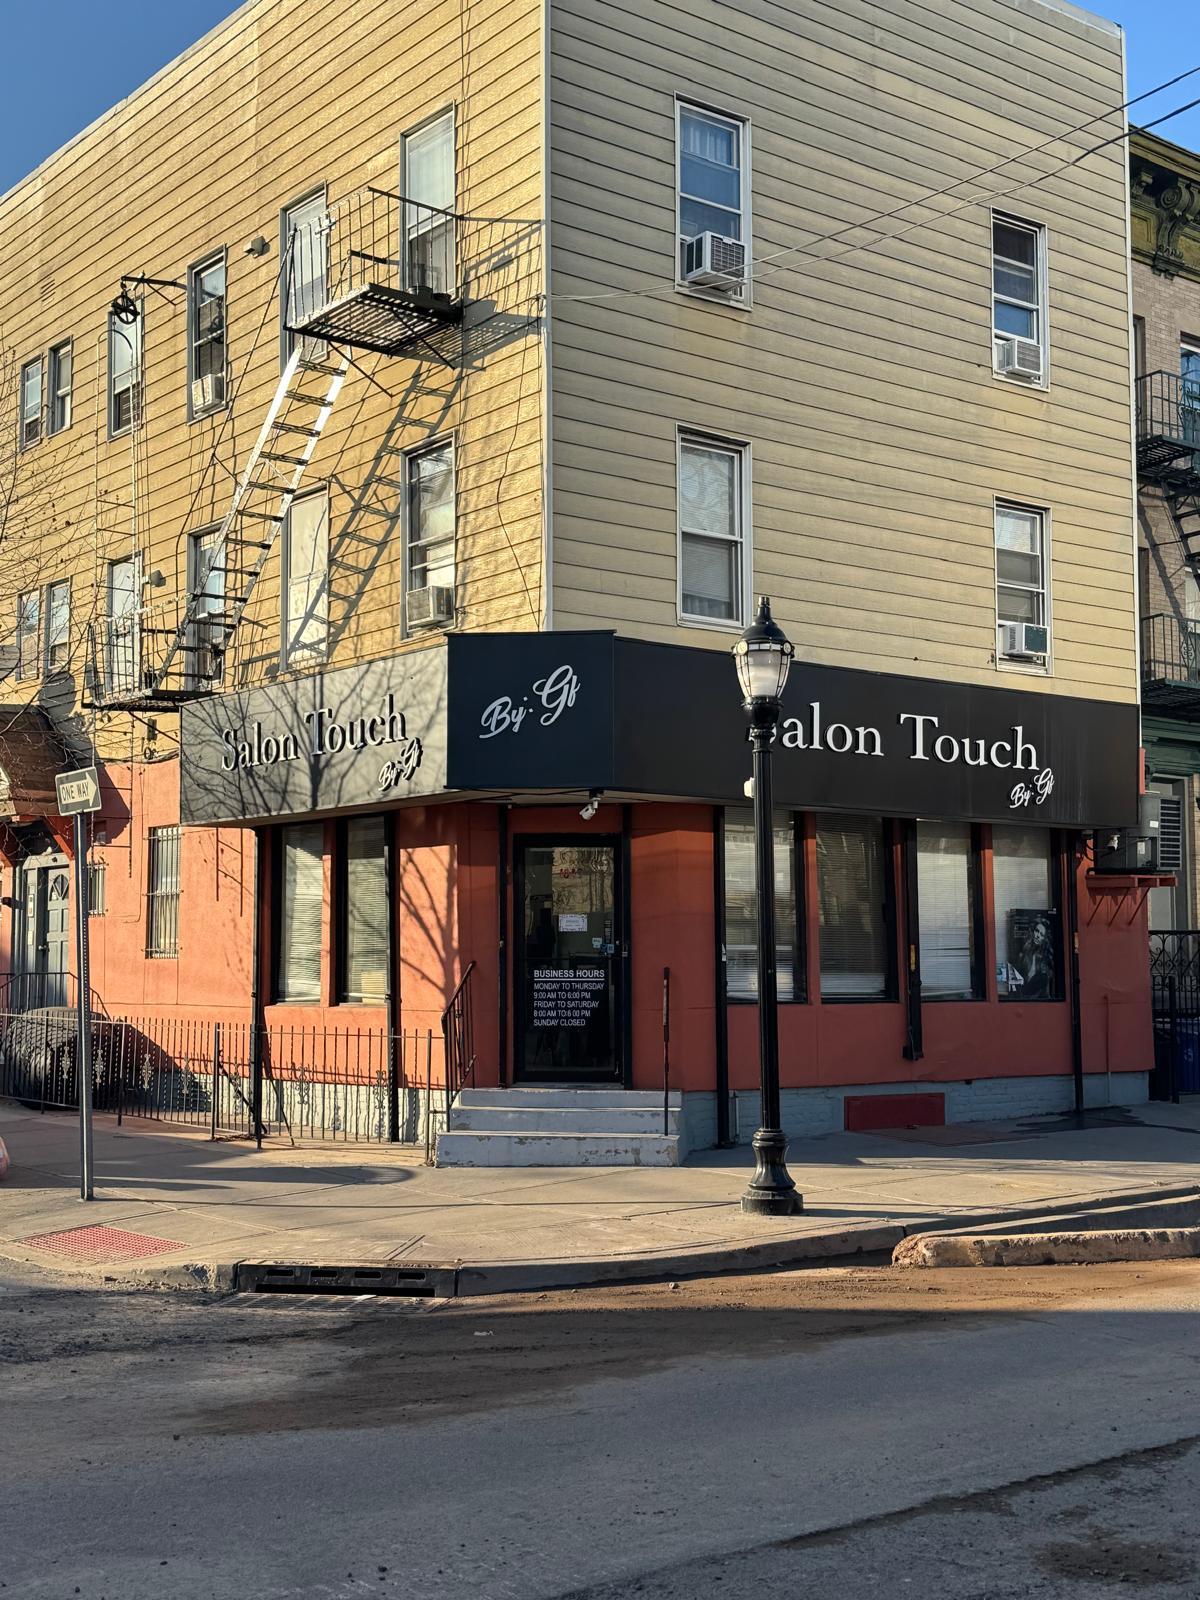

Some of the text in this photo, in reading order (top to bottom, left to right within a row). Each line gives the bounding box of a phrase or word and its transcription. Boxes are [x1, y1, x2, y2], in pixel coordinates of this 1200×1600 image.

[220, 692, 408, 772] Salon Touch
[899, 713, 1040, 772] Touch
[61, 782, 90, 801] ONE WAY
[533, 969, 605, 978] BUSINESS HOURS
[533, 982, 605, 990] MONDAY TO THURSDAY
[547, 991, 557, 999] AM
[557, 991, 567, 999] TO
[581, 991, 591, 999] PM
[533, 1000, 600, 1008] FRIDAY TO SATURDAY
[547, 1009, 557, 1017] AM
[558, 1009, 567, 1017] TO
[581, 1009, 591, 1017] PM
[533, 1018, 586, 1026] SUNDAY CLOSED
